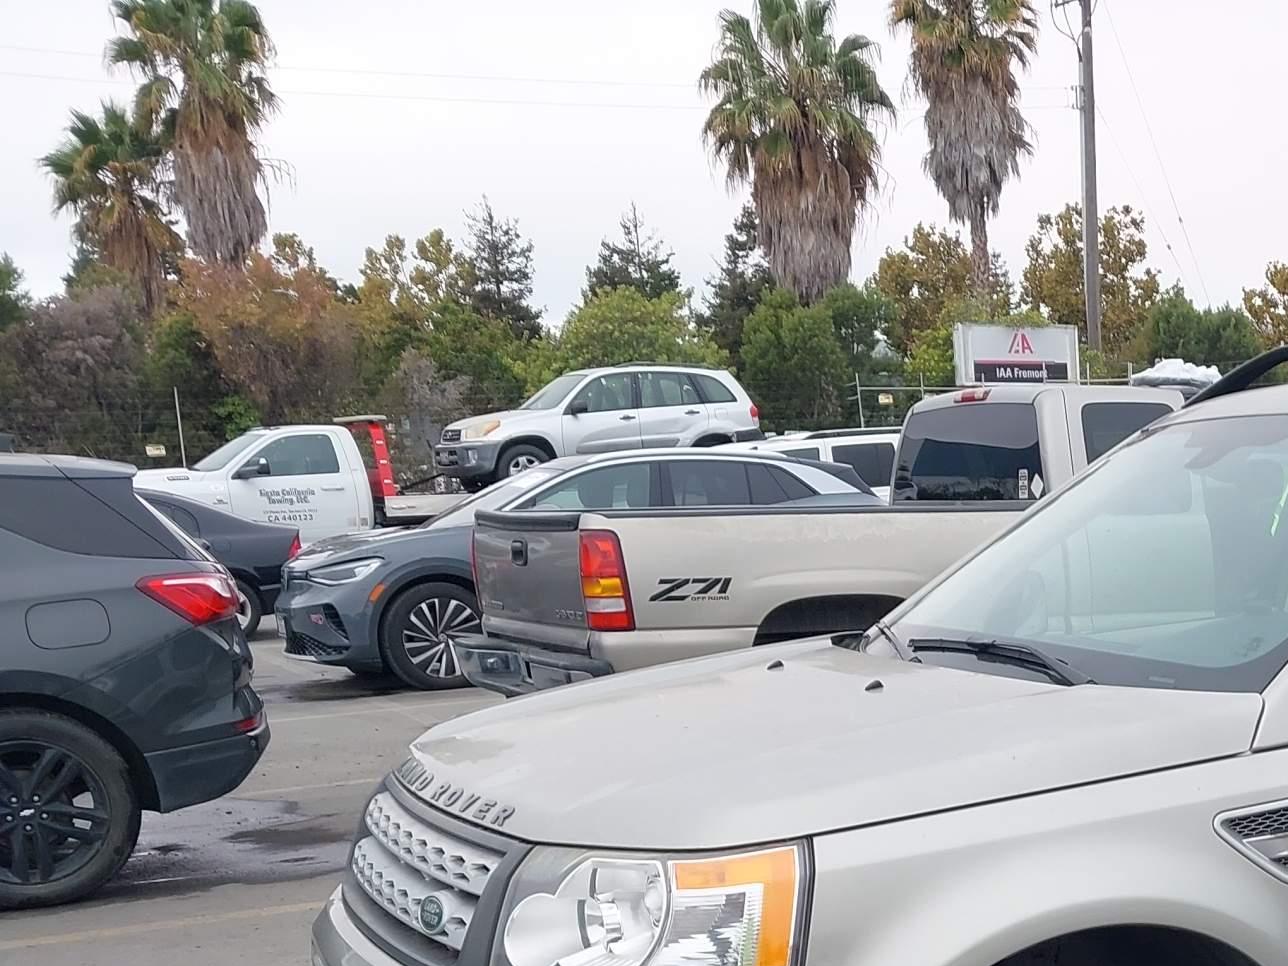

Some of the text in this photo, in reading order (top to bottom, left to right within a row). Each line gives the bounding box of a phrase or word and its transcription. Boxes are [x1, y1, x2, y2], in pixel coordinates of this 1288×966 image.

[996, 367, 1013, 378] IAA
[281, 487, 316, 497] California
[267, 514, 281, 522] CA
[648, 577, 733, 602] Z71
[430, 783, 516, 828] ROVER
